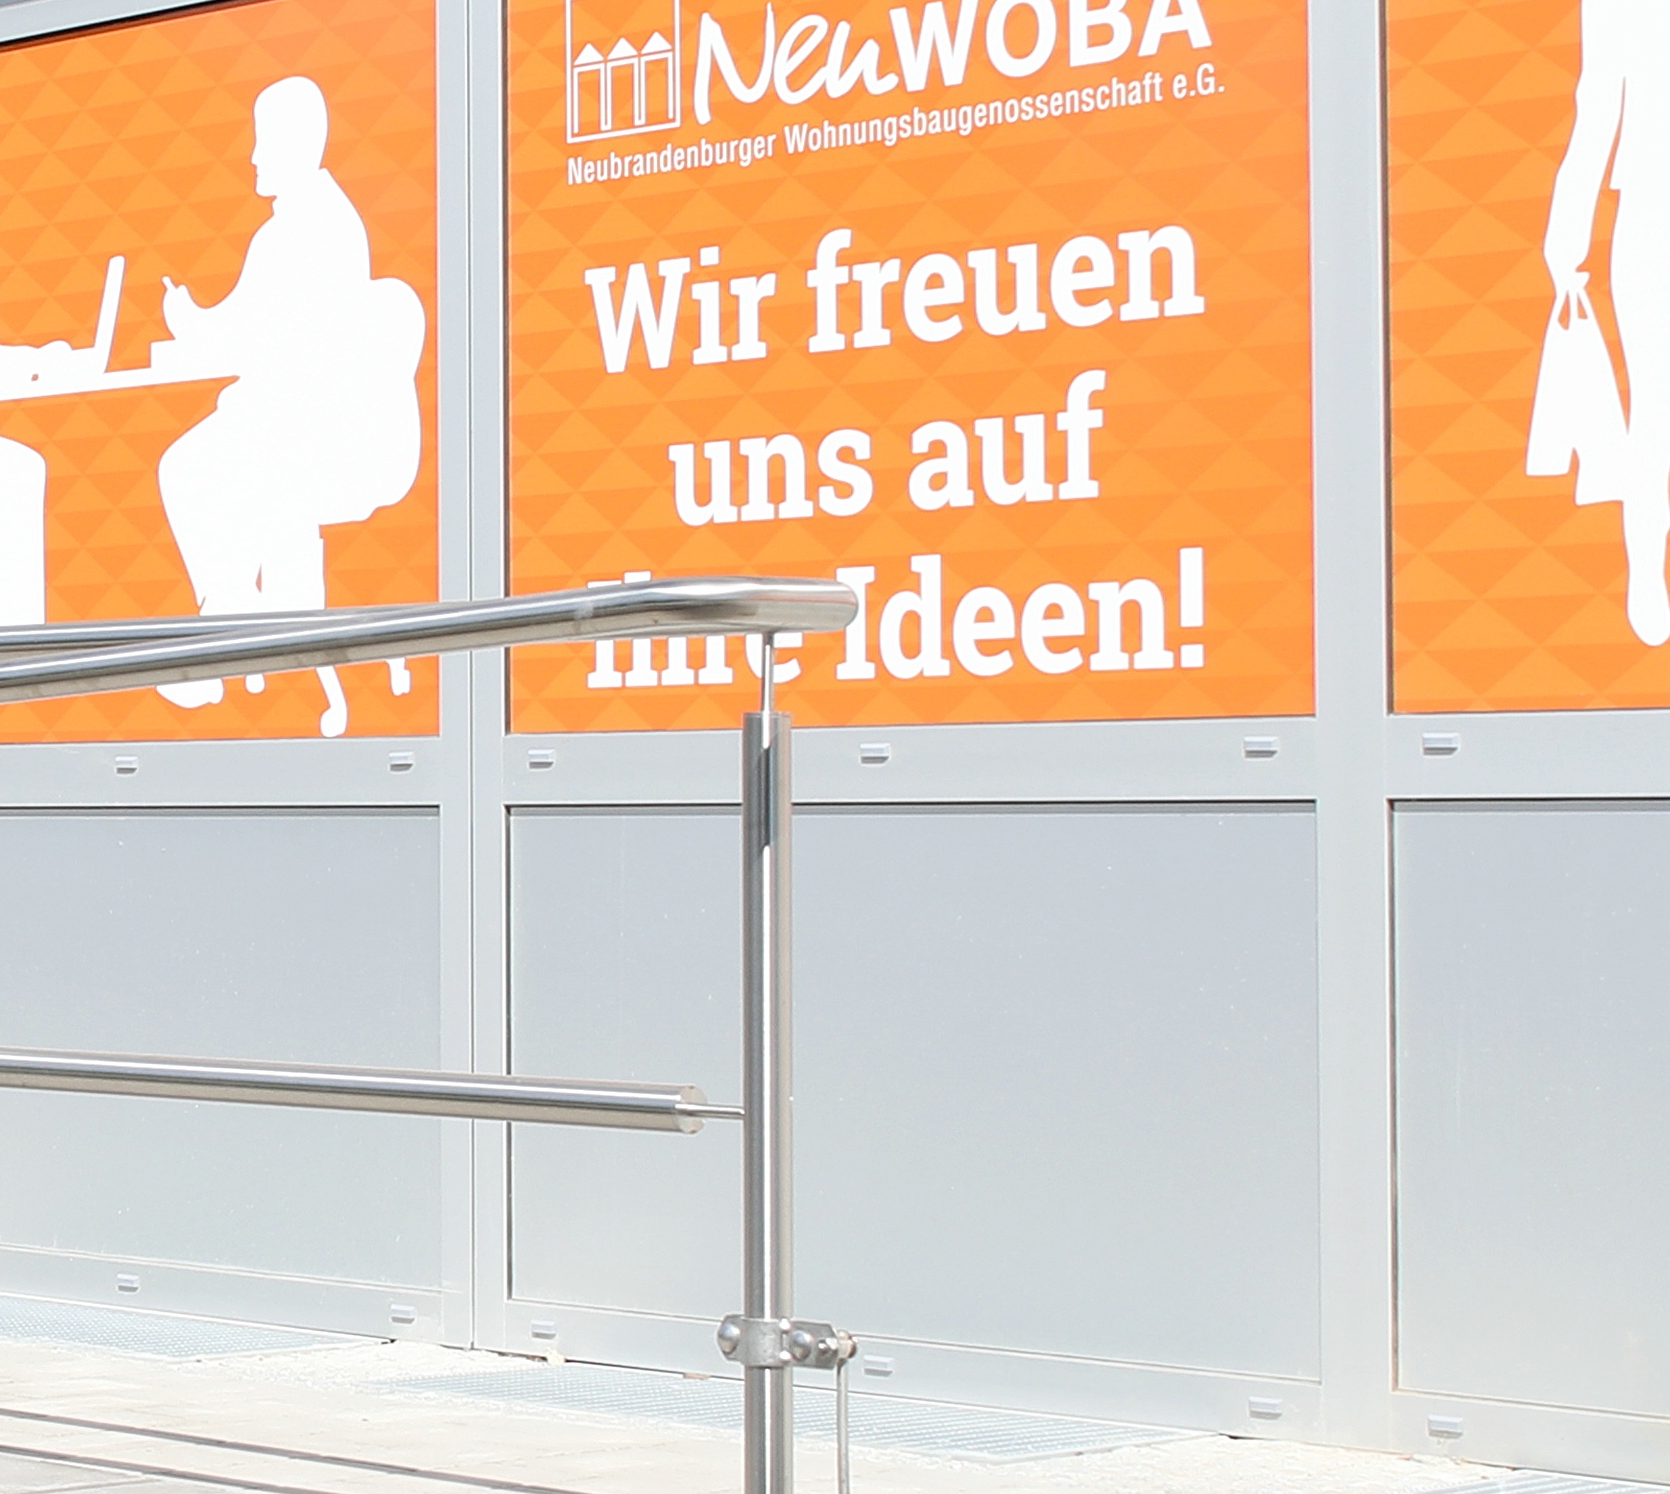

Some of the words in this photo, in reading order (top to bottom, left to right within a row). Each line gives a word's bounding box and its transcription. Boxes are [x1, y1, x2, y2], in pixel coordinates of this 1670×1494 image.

[567, 134, 776, 185] Neubrandenburger
[784, 71, 1163, 154] Wohnungsbaugenossenschaft
[1172, 63, 1226, 99] e.G.
[584, 246, 777, 374] Wir
[806, 225, 1206, 354] freuen
[668, 429, 874, 526] uns
[908, 369, 1107, 511] auf
[835, 547, 1206, 681] Ideen!
